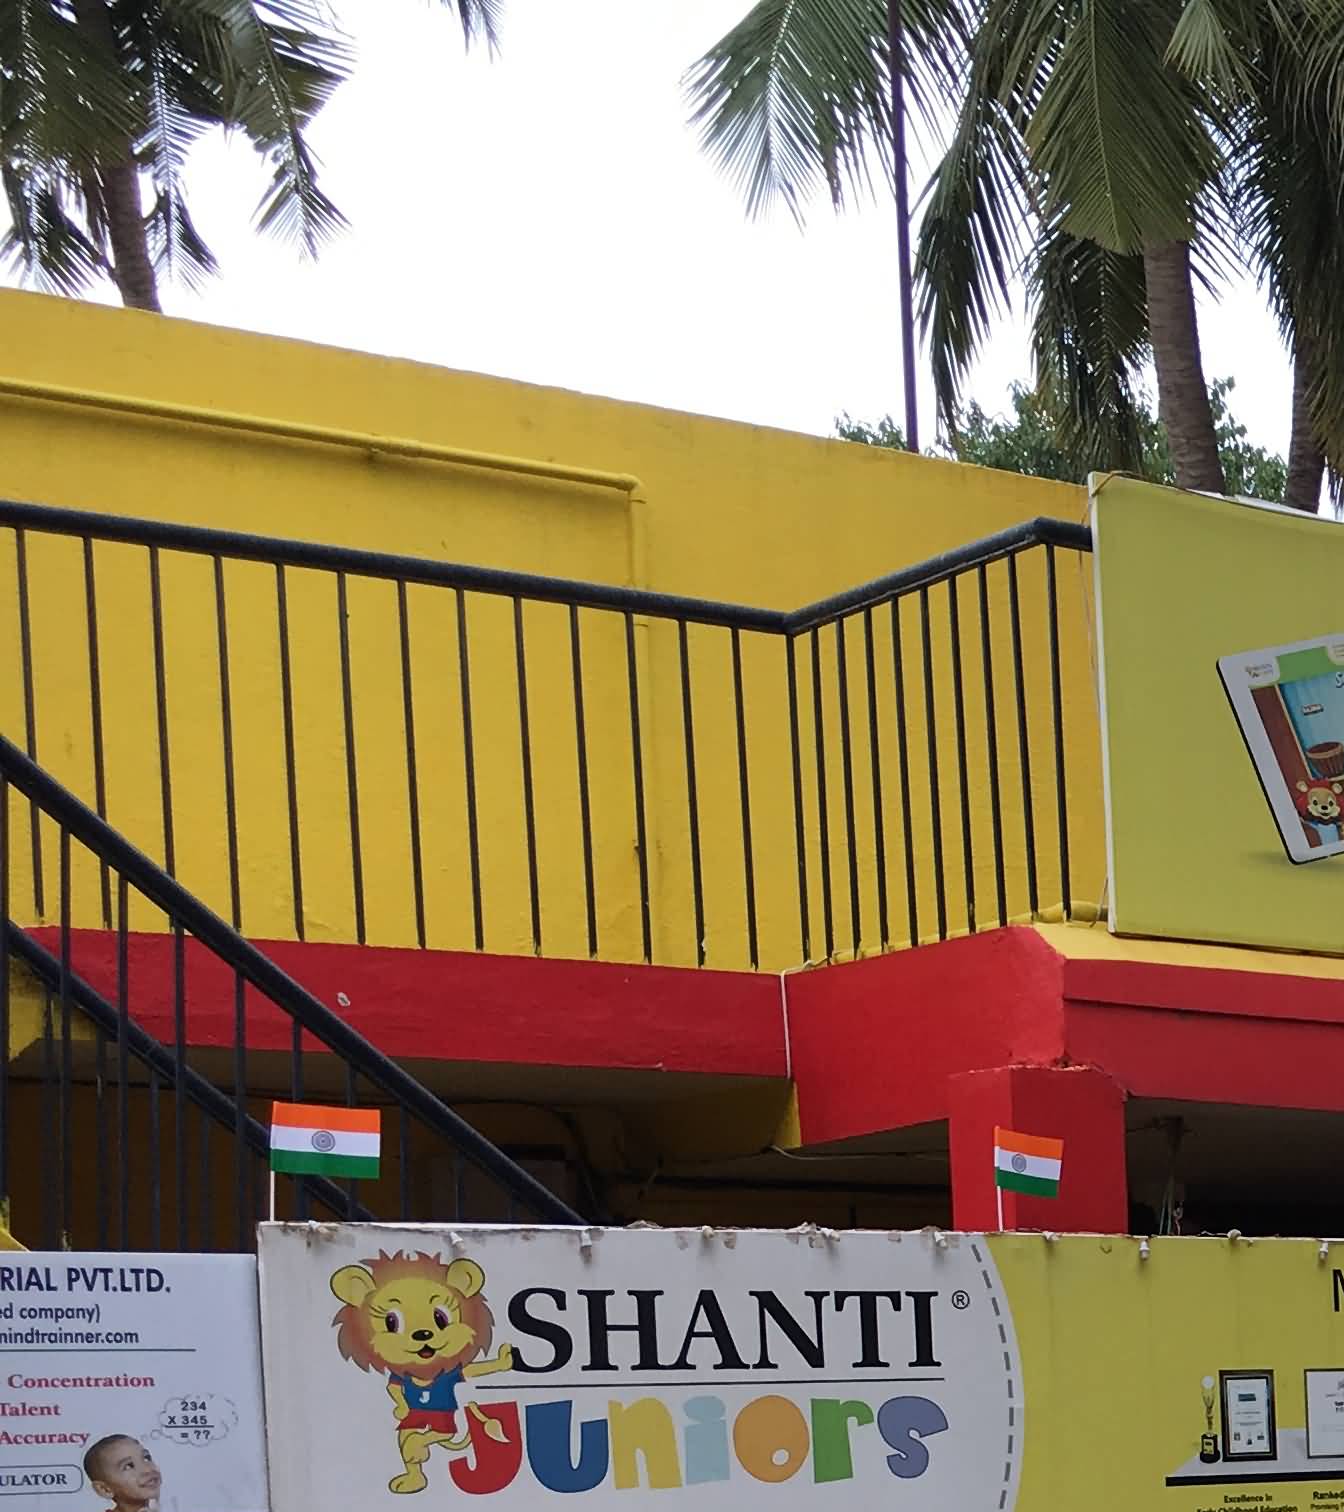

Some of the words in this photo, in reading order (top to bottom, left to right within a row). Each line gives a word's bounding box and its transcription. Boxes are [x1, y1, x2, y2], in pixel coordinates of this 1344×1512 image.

[66, 1267, 171, 1293] PVT.LTD.
[19, 1303, 101, 1324] company)
[7, 1373, 156, 1389] Concentration
[0, 1402, 61, 1417] Talent
[180, 1401, 207, 1411] 234
[181, 1415, 208, 1425] 345
[0, 1431, 91, 1448] Accuracy
[1223, 1494, 1264, 1504] Excellence
[1313, 1490, 1344, 1500] Ranked
